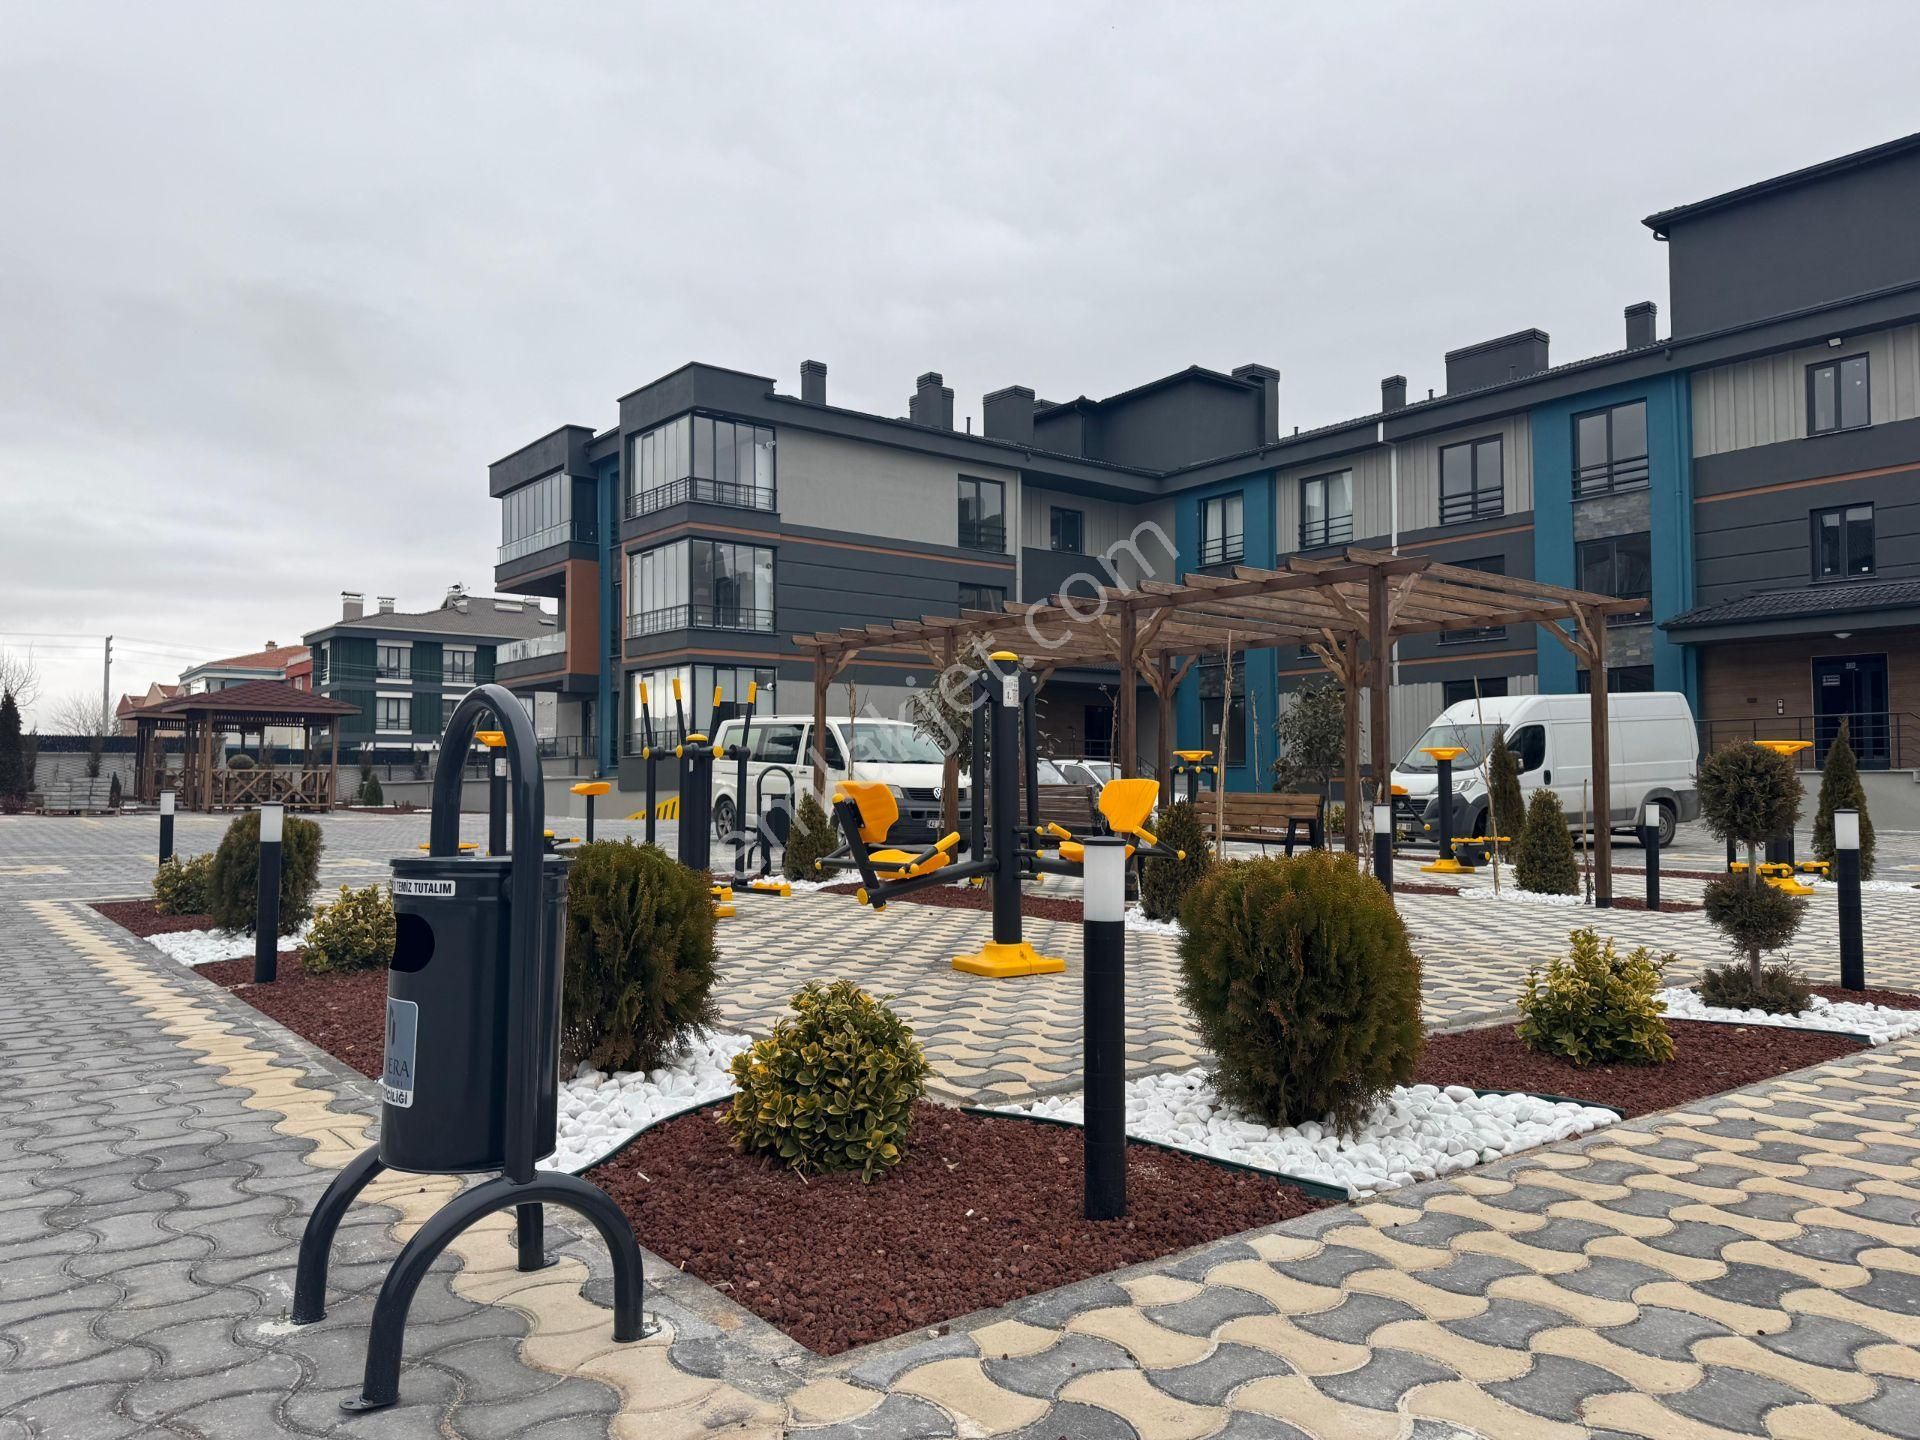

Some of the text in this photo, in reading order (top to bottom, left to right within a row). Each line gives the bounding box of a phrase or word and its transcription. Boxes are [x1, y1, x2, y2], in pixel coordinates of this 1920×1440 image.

[396, 880, 412, 893] TEMİZ
[413, 882, 452, 894] TUTALIM
[386, 1057, 410, 1078] ERA
